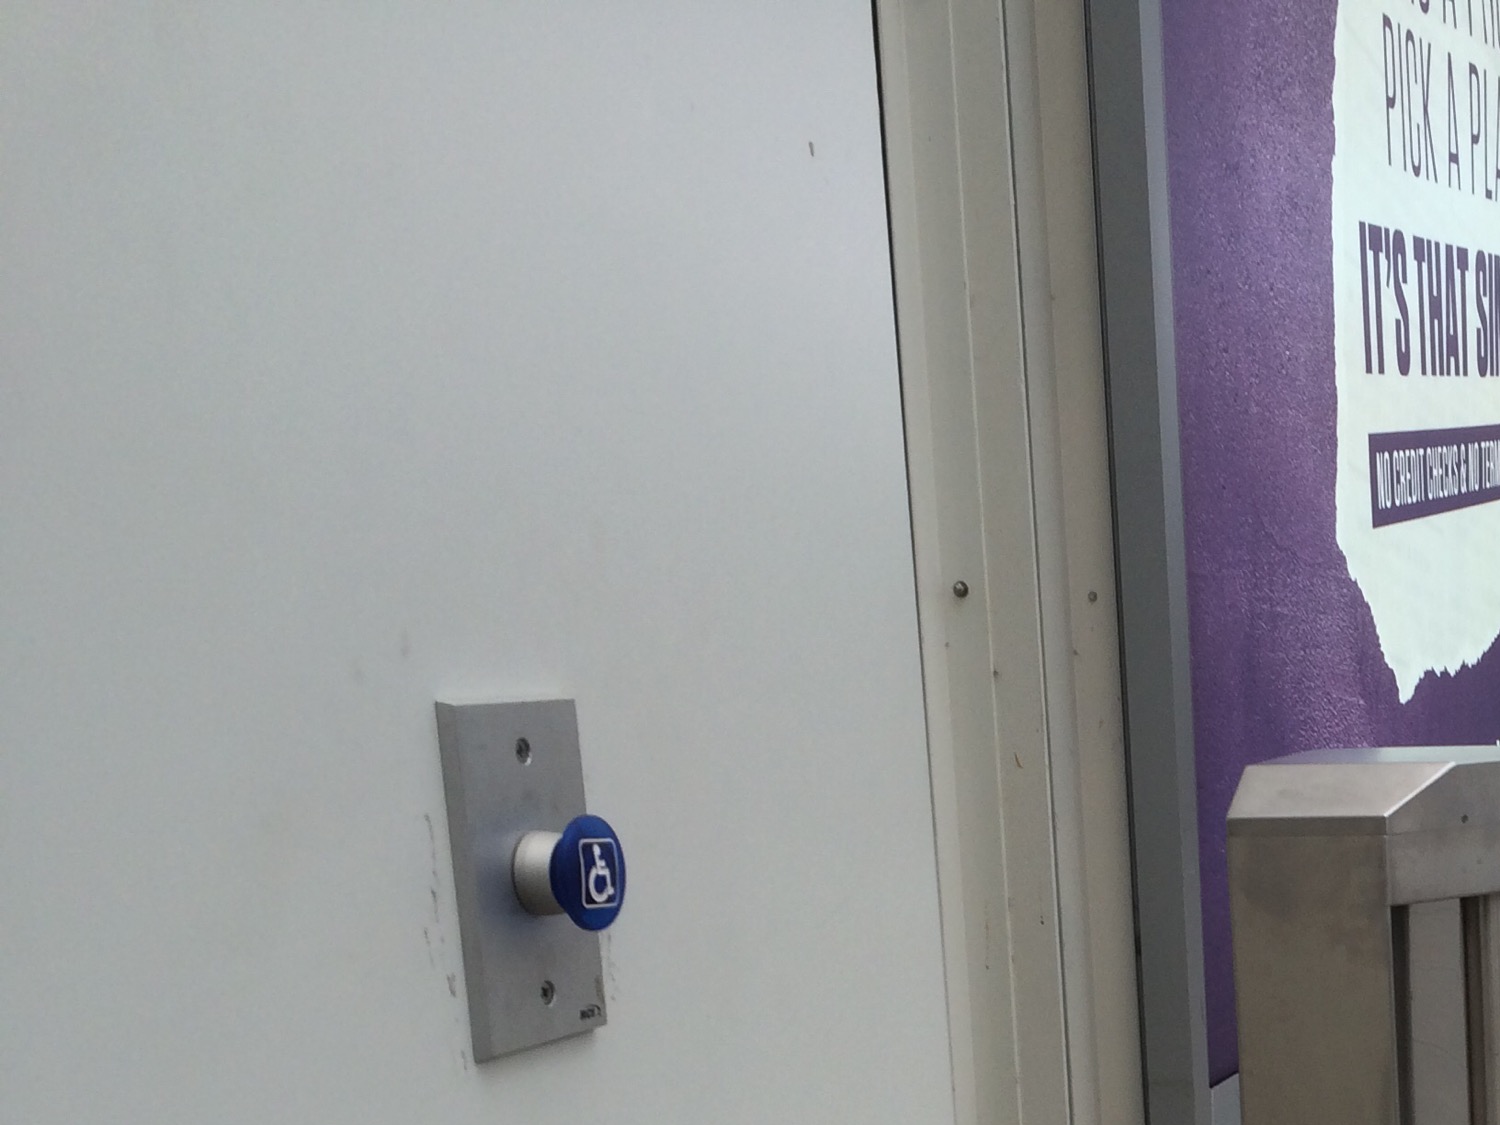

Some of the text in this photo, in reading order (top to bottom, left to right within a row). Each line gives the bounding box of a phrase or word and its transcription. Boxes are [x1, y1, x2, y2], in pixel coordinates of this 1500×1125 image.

[1382, 12, 1438, 184] PICK
[1447, 52, 1461, 190] A
[1358, 220, 1411, 377] IT'S
[1412, 235, 1469, 377] THAT
[1376, 451, 1393, 510] NO
[1393, 447, 1426, 507] CREDIT
[1426, 444, 1459, 501] CHECKS
[1460, 443, 1468, 494] &
[1468, 441, 1480, 493] NO
